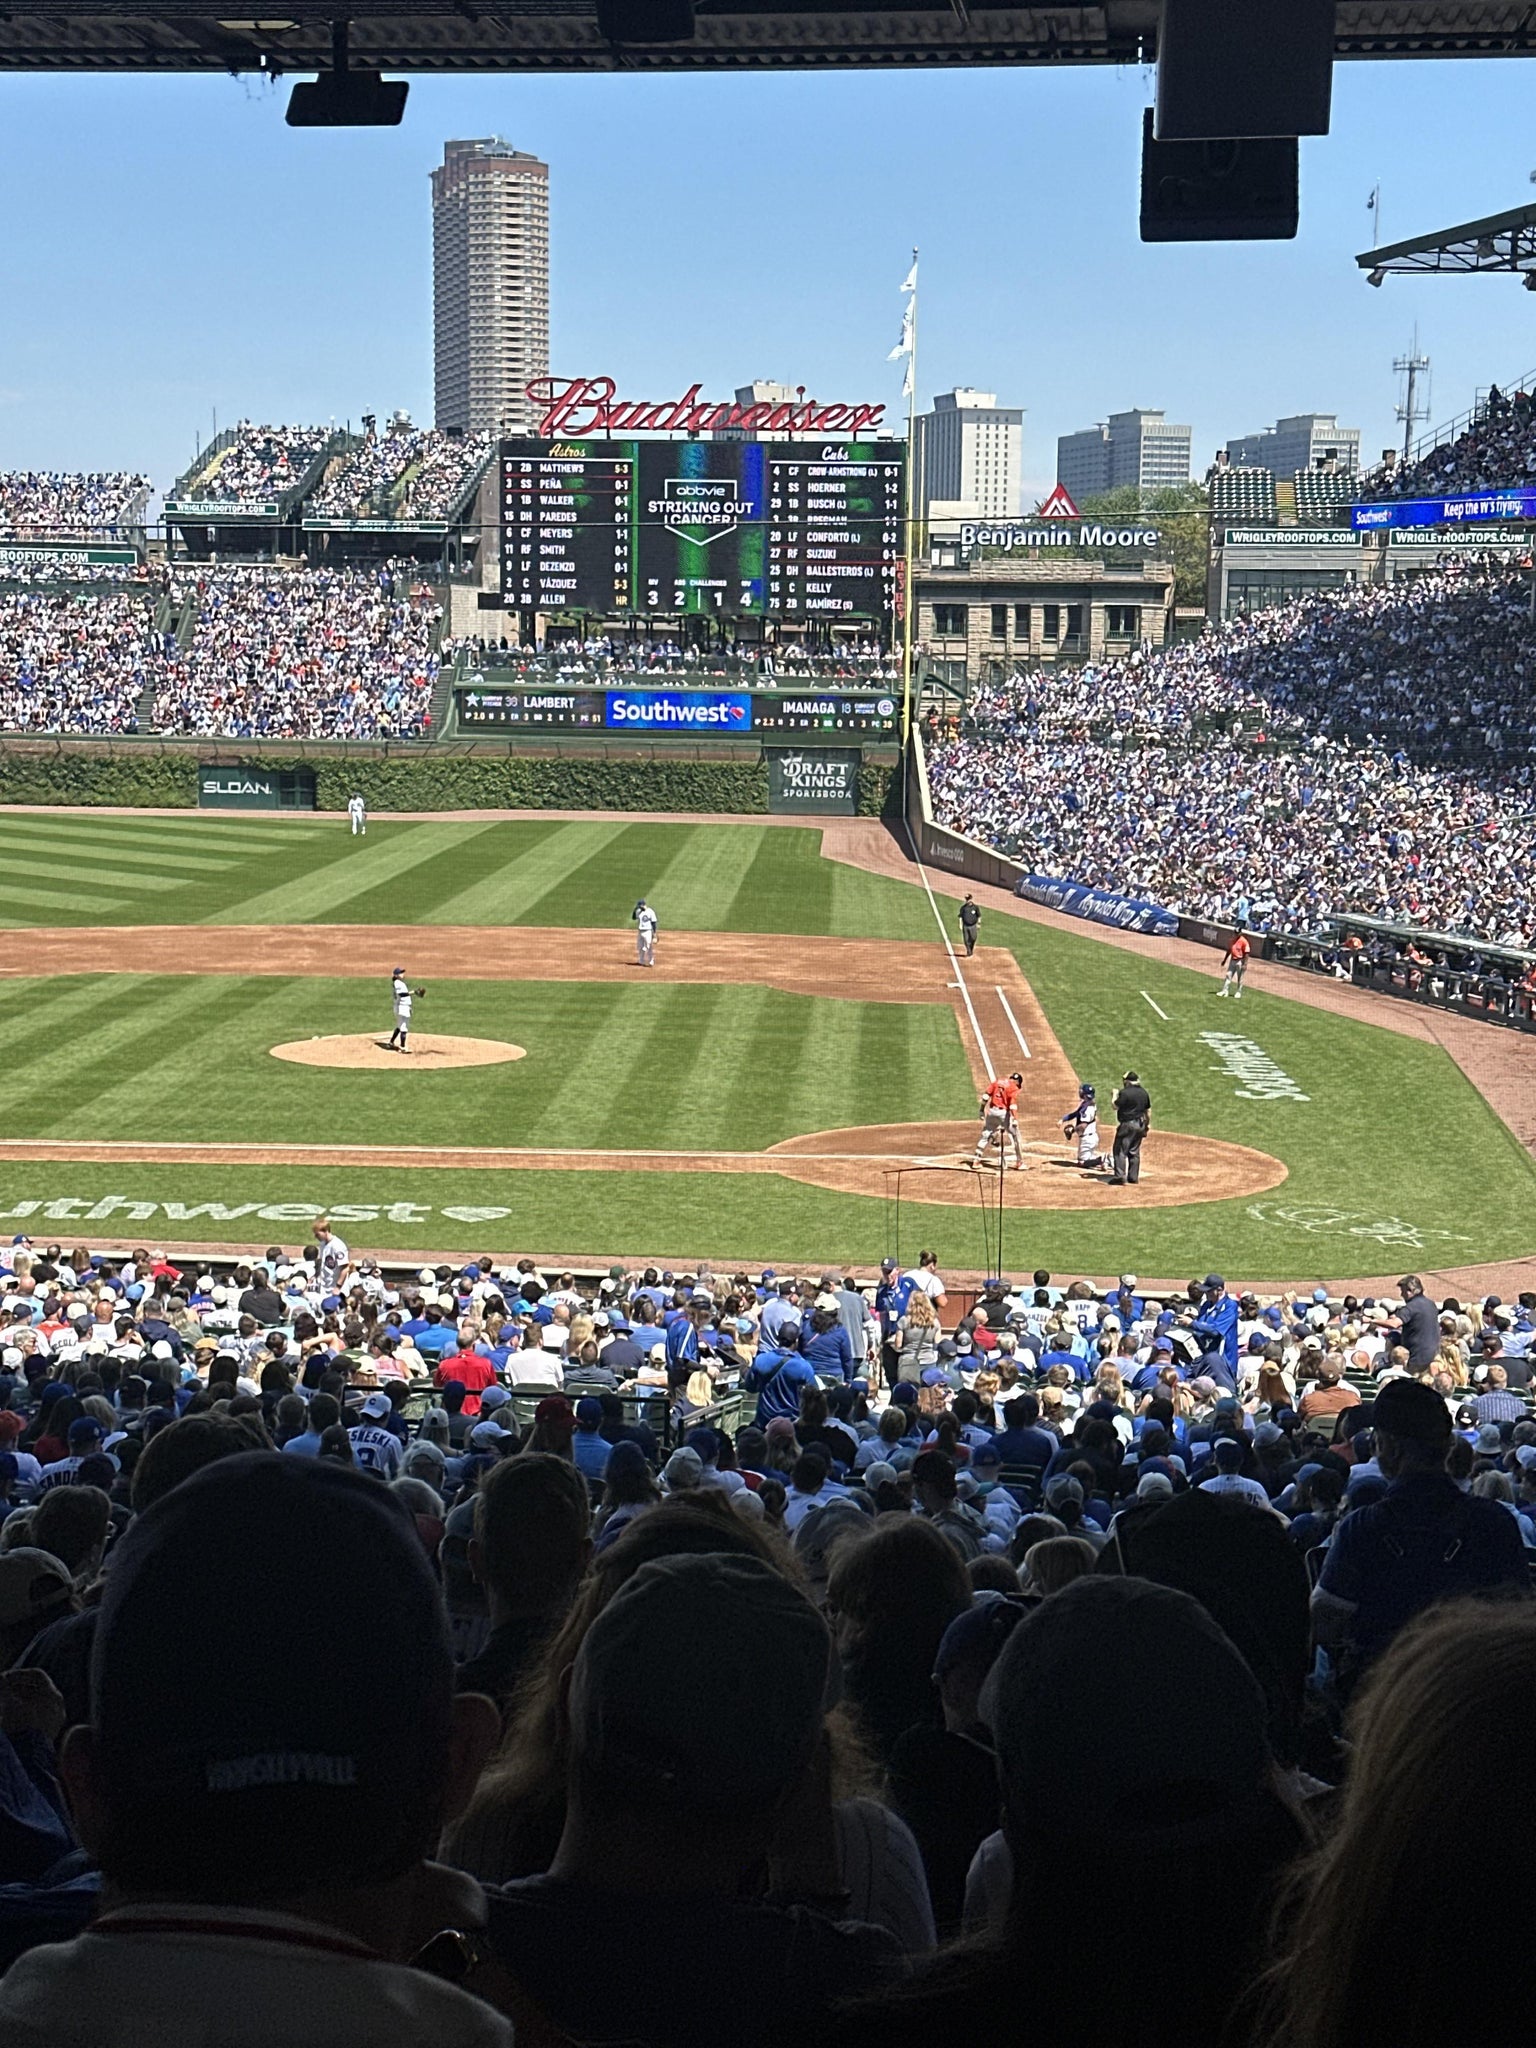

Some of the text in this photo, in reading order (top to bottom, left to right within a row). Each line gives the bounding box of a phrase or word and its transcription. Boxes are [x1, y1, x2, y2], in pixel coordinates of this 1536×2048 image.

[525, 376, 886, 437] Budweiser
[549, 443, 586, 457] Astros
[822, 446, 848, 460] Cubs
[506, 462, 628, 473] 0 2B MATTHEWS 5-3
[773, 466, 780, 475] 4
[789, 466, 799, 476] CF
[885, 467, 898, 476] 0-1
[506, 478, 628, 490] 3 SS PEÑA 0-1
[773, 482, 898, 493] 2 SS HOERNER 1-2
[676, 486, 726, 496] abbvie
[521, 495, 531, 504] 1B
[540, 496, 574, 505] WALKER
[615, 496, 628, 506] 0-1
[771, 498, 896, 509] 29 1B BUSCH (L) 1-1
[648, 501, 754, 514] STRIKING OUT
[1444, 502, 1464, 520] Keep
[1465, 499, 1480, 515] the
[504, 511, 628, 523] 15 DH PAREDES 0-1
[670, 514, 731, 526] CANCER
[1356, 508, 1388, 524] Southwest
[506, 527, 627, 540] 6 CF MEYERS 1-1
[770, 531, 781, 541] 20
[788, 532, 798, 541] LF
[807, 532, 849, 542] CONFORTO
[882, 532, 896, 543] 0-2
[961, 524, 1157, 551] Benjamin Moore
[1232, 532, 1356, 543] WRIGLEYROOFTOPS.COM
[505, 544, 627, 556] 11 RF SMITH 0-1
[770, 548, 896, 559] 27 RF SUZUKI 0-1
[506, 561, 627, 573] 9 LF DEZENZO 0-1
[770, 565, 780, 575] 25
[787, 566, 798, 575] DH
[807, 566, 862, 576] BALLESTEROS
[506, 577, 627, 590] 2 C VÁZQUEZ 5-3
[770, 582, 895, 594] 15 C KELLY 1-1
[504, 593, 627, 605] 20 3B ALLEN HR
[648, 590, 752, 606] 3 2 1 4
[770, 598, 780, 608] 75
[786, 599, 797, 608] 2B
[806, 598, 842, 609] RAMÍREZ
[524, 696, 575, 708] LAMBERT
[783, 701, 835, 714] IMANAGA
[547, 713, 552, 721] 2
[613, 700, 728, 722] Southwest
[814, 719, 818, 727] 2
[783, 762, 849, 777] DRAFT
[791, 774, 846, 788] KINGS
